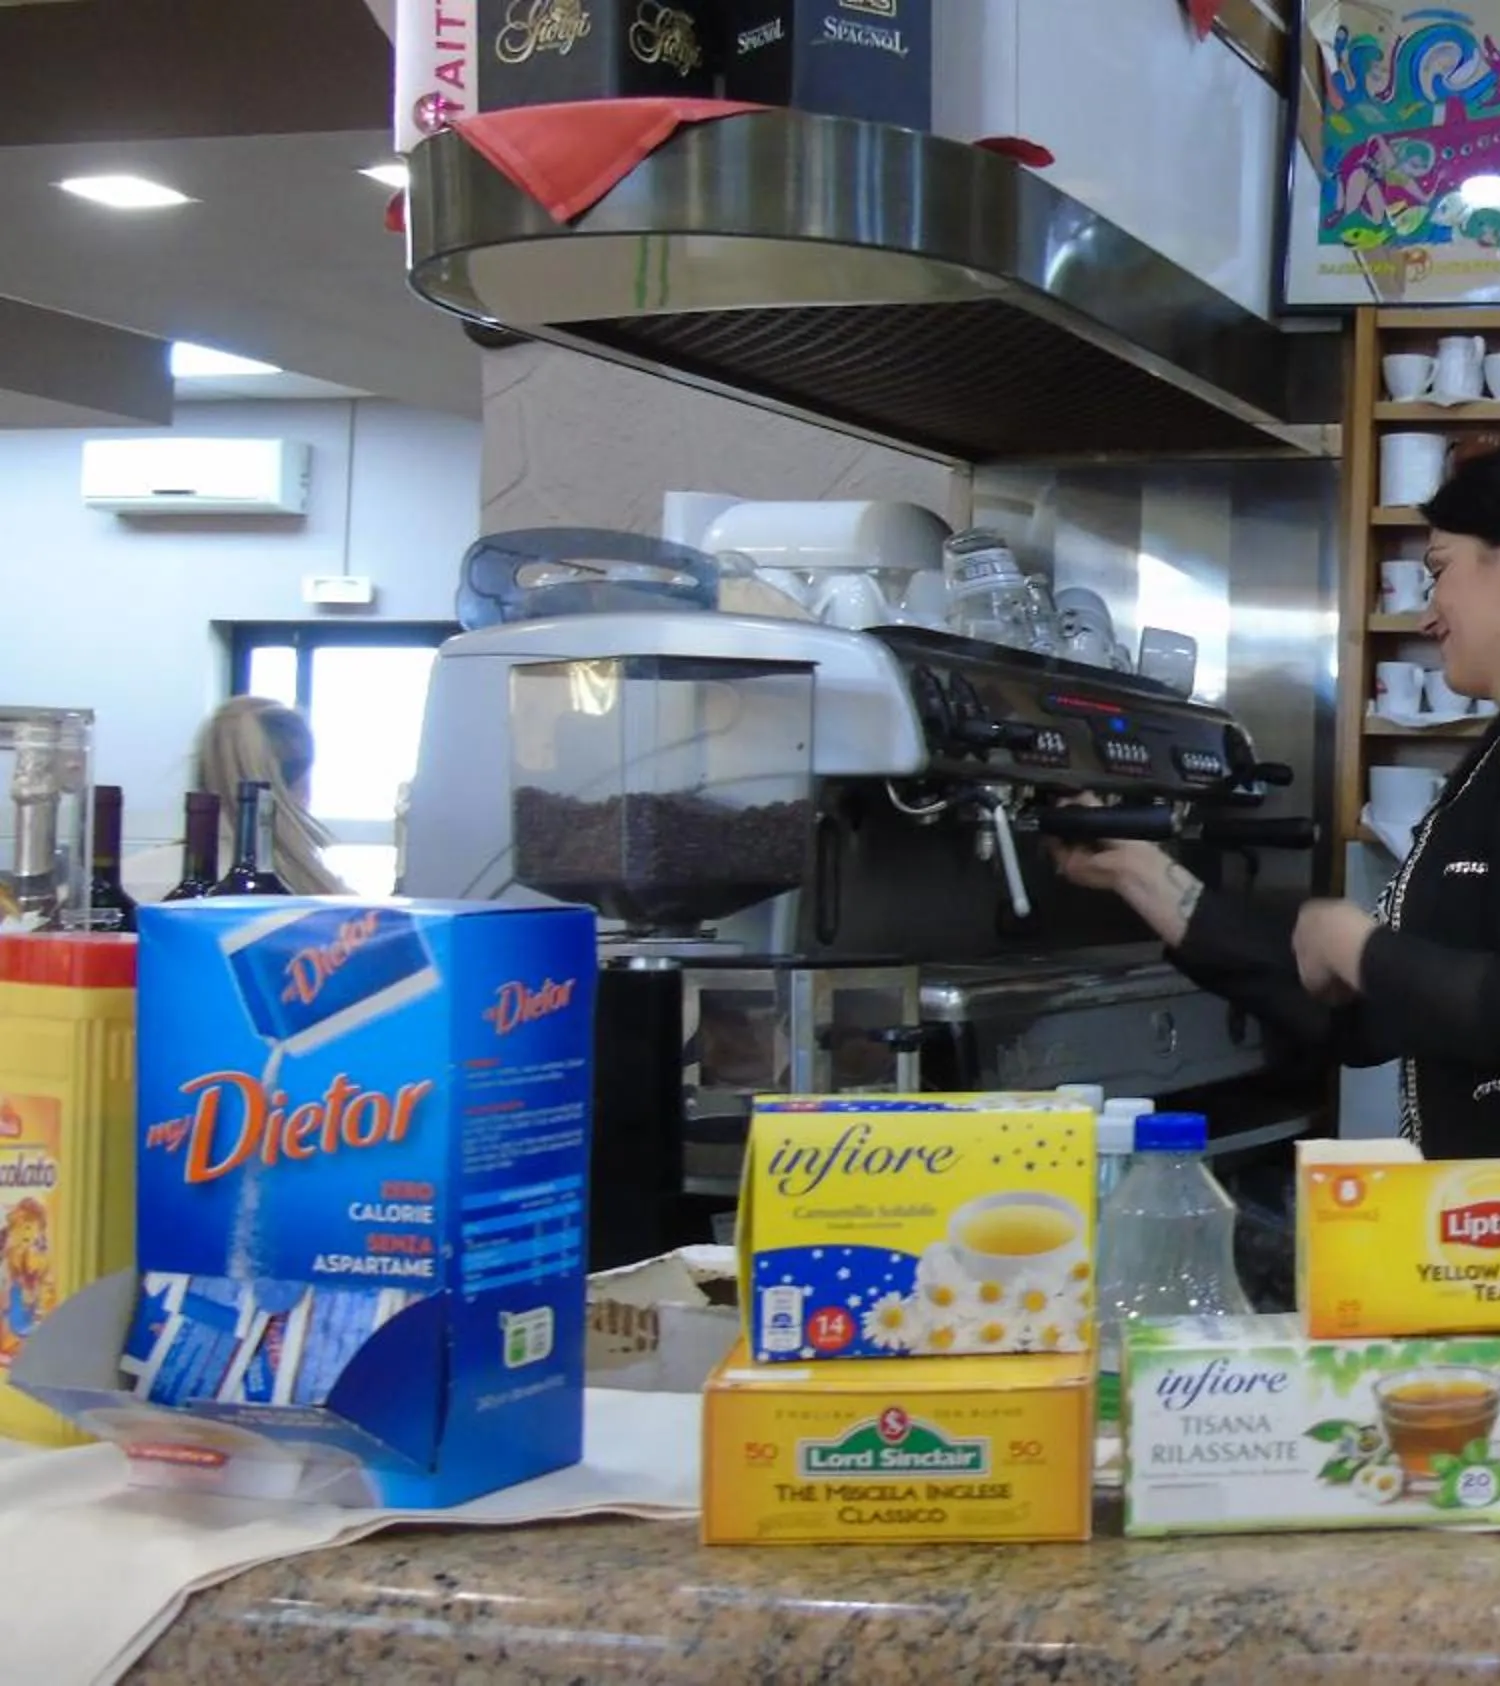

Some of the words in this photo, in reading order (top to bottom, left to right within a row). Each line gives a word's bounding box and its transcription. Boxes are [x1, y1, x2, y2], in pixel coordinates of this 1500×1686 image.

[822, 16, 909, 58] SPAGNOL
[146, 1114, 195, 1152] my
[178, 1069, 434, 1184] Dietor
[768, 1122, 964, 1197] infiore
[348, 1201, 435, 1224] CALORIE
[311, 1253, 435, 1278] ASPARTAME
[1416, 1263, 1500, 1282] YELLOW
[815, 1314, 846, 1337] 14
[1156, 1356, 1290, 1411] infiore
[1181, 1414, 1272, 1436] TISANA
[809, 1449, 875, 1468] Lord
[879, 1447, 977, 1468] Sinclair
[1151, 1440, 1299, 1464] RILASSANTE
[925, 1482, 1013, 1500] INGLESE
[1463, 1472, 1491, 1488] 20
[837, 1506, 947, 1525] CLASSICO
